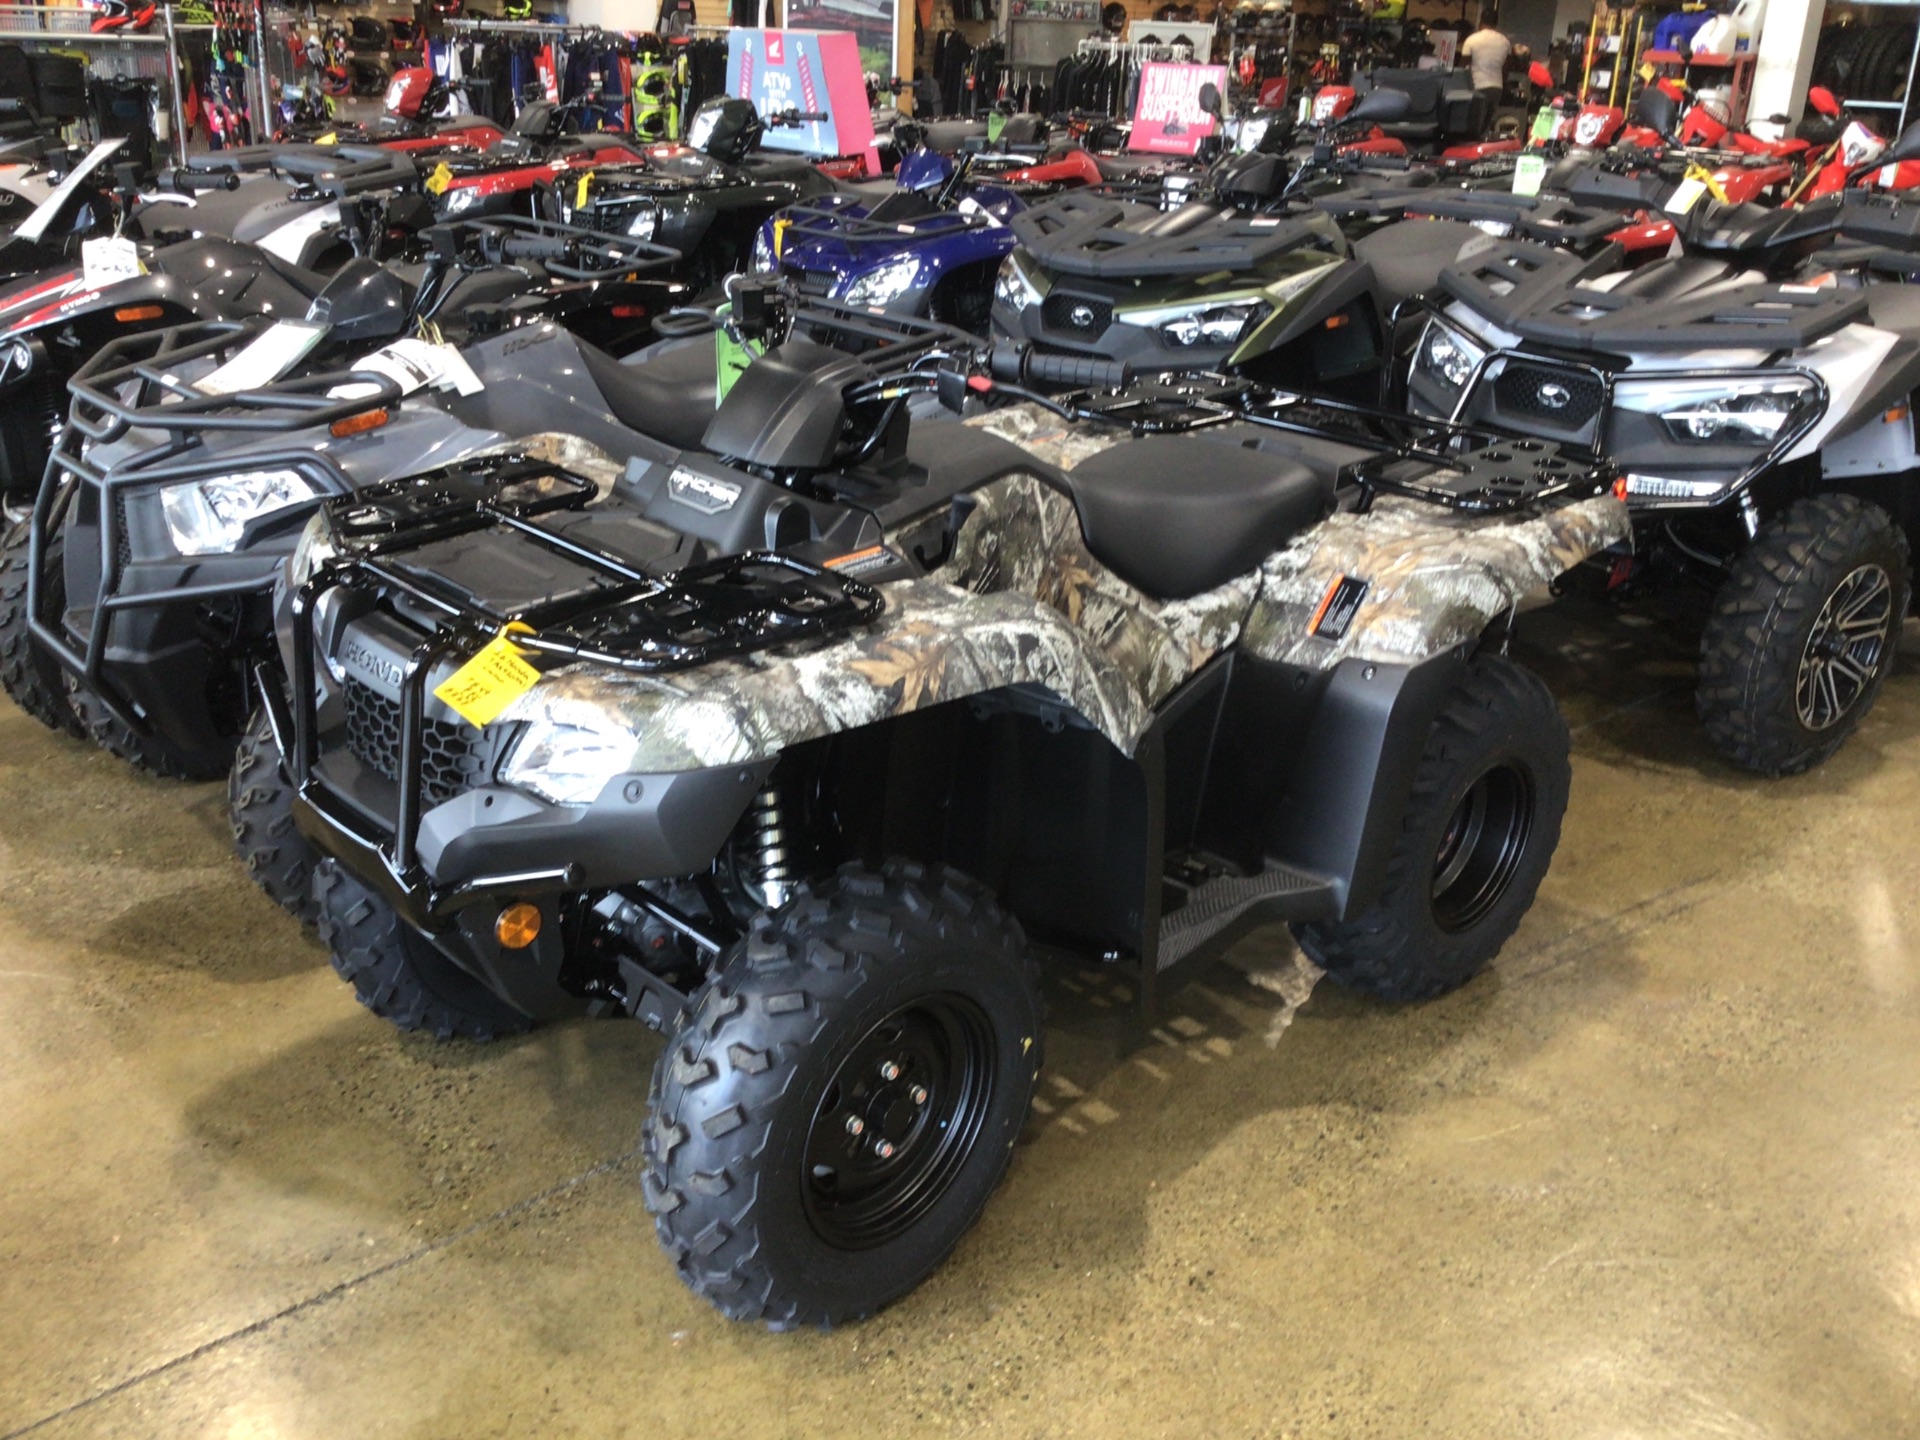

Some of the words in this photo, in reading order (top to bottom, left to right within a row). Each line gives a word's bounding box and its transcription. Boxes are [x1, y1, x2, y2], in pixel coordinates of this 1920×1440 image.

[762, 71, 792, 91] ATVs
[1145, 66, 1220, 98] SWINGARM
[345, 641, 404, 689] HOND
